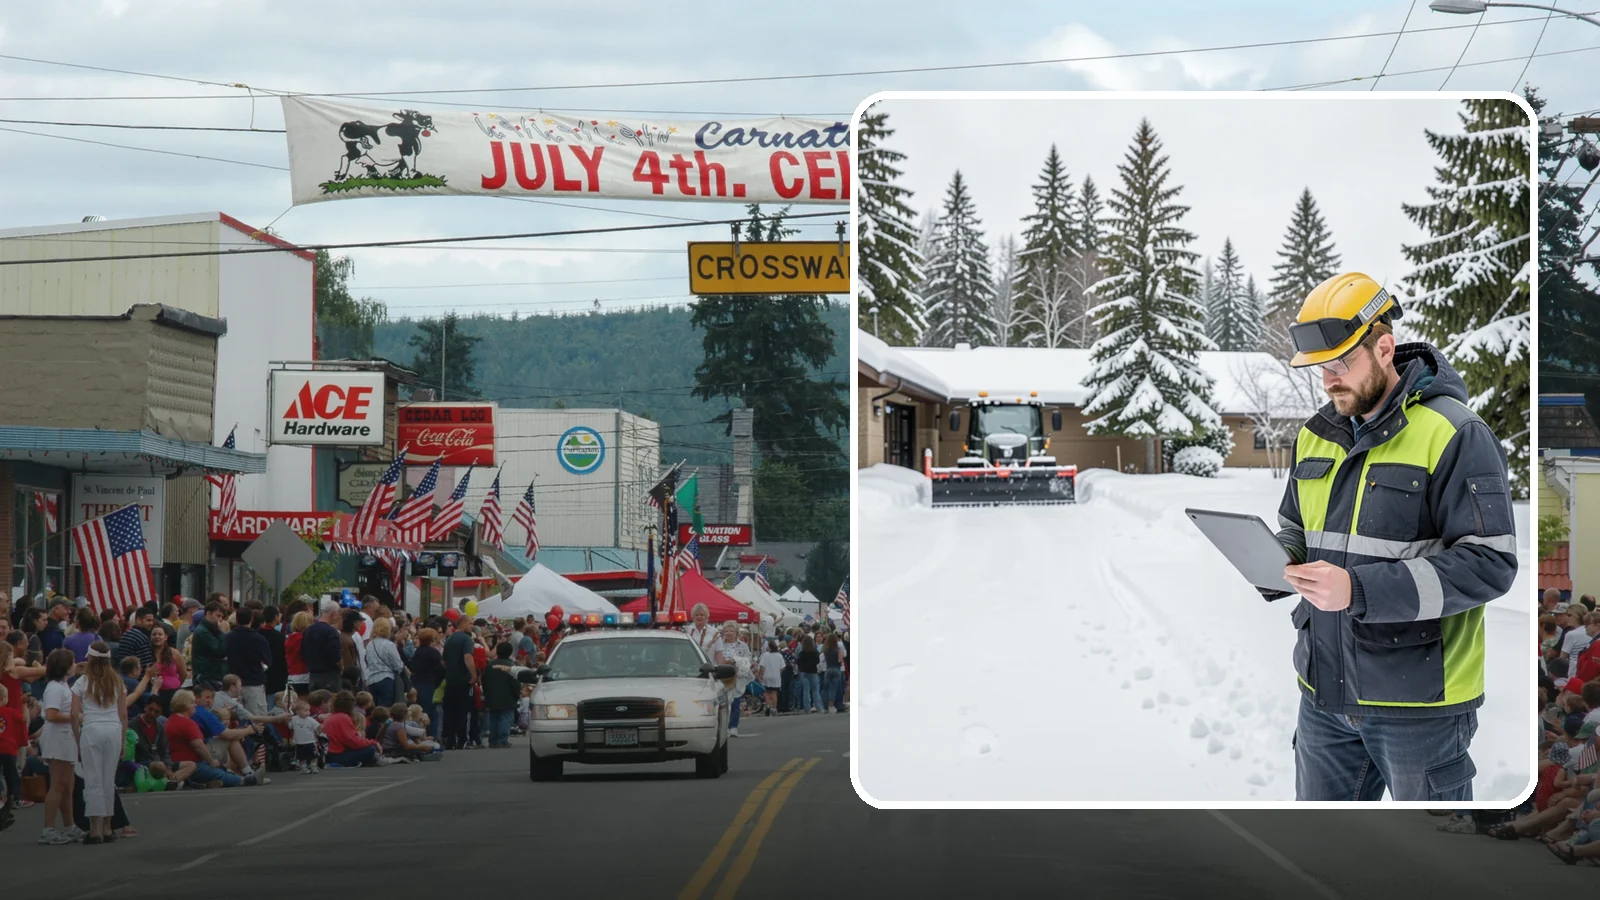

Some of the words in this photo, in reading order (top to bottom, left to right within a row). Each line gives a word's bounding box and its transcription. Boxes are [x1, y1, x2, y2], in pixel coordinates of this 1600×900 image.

[695, 121, 850, 149] Carnat
[481, 141, 604, 192] JULY
[632, 150, 746, 197] 4th.
[697, 254, 850, 280] CROSSWA
[283, 380, 373, 419] ACE
[406, 409, 452, 421] CEDAR
[283, 421, 370, 436] Hardware
[83, 486, 93, 494] St.
[96, 485, 124, 494] Vincent
[126, 486, 135, 494] de
[137, 486, 155, 495] Paul
[699, 535, 730, 543] GLASS
